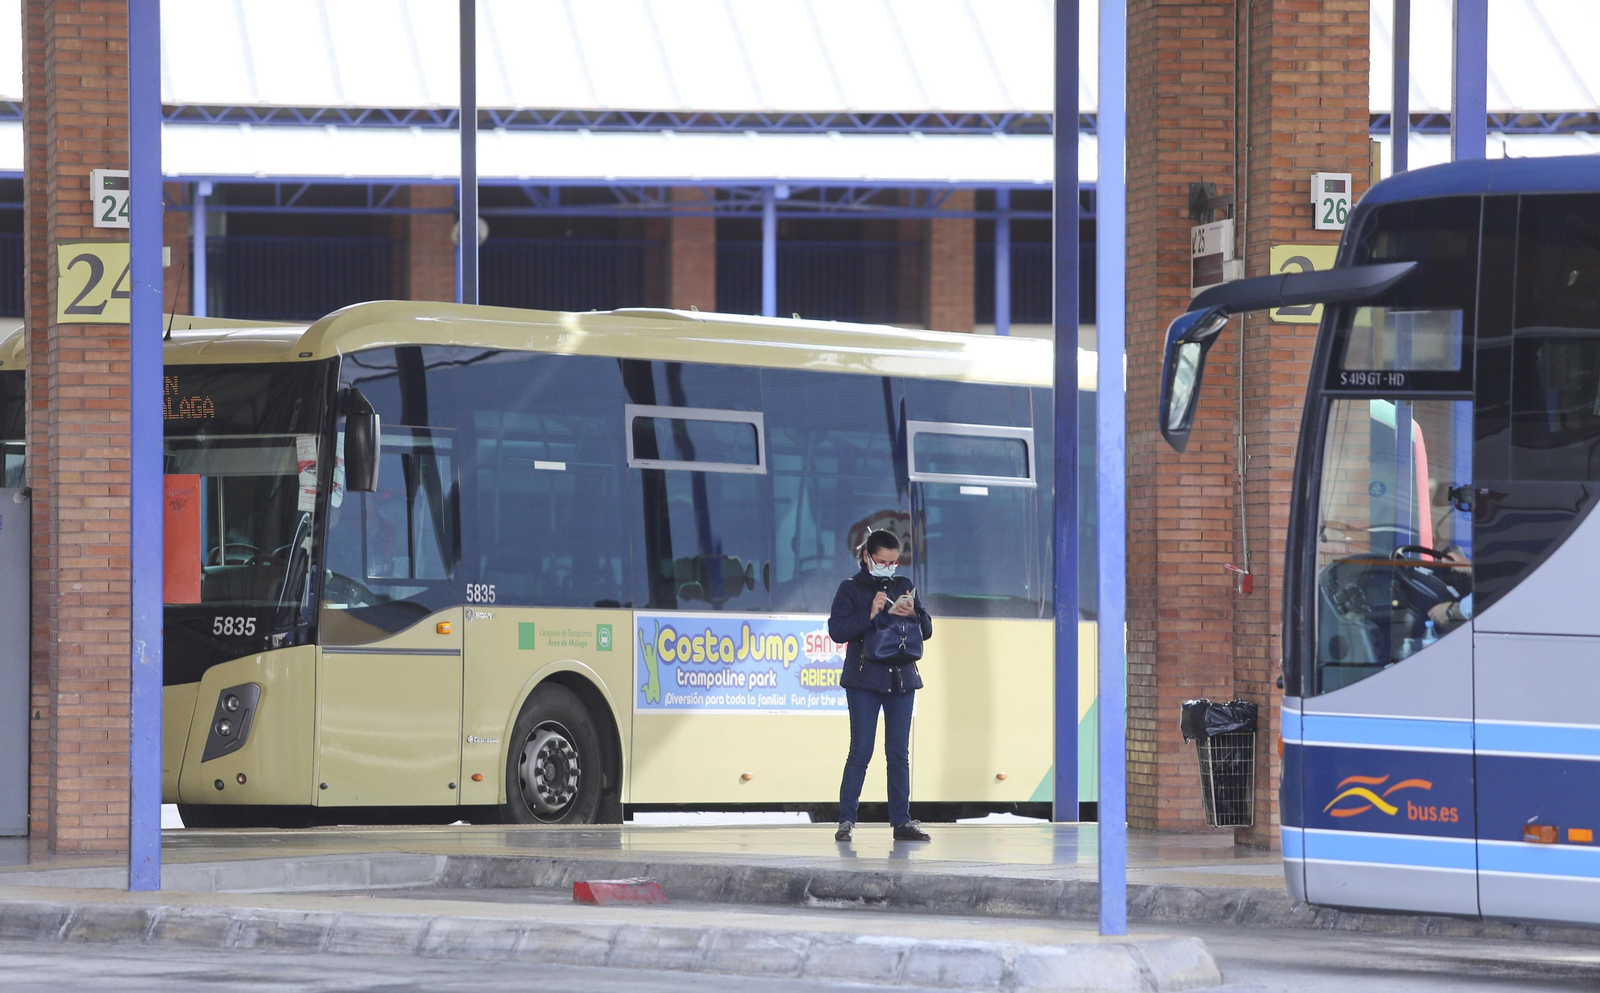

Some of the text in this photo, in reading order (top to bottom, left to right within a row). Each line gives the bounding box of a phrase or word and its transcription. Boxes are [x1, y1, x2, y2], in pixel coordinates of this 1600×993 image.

[101, 195, 130, 222] 24
[1322, 197, 1348, 224] 26
[1198, 228, 1205, 253] 25
[163, 375, 178, 395] N
[1340, 372, 1347, 385] S
[1349, 372, 1366, 385] 419
[466, 583, 496, 603] 5835
[212, 616, 256, 636] 5835
[539, 628, 560, 636] Consorcio
[568, 629, 592, 639] Transportes
[548, 637, 588, 649] Área de Málaga
[806, 634, 832, 653] SAN
[677, 668, 777, 690] trampoline park
[664, 692, 704, 707] ¡Diversión
[705, 695, 724, 707] para
[725, 693, 746, 705] toda
[747, 693, 756, 705] la
[757, 693, 786, 708] familia!
[791, 693, 806, 706] Fun
[807, 694, 819, 708] for
[820, 694, 836, 706] the
[1407, 800, 1459, 823] bus.es
